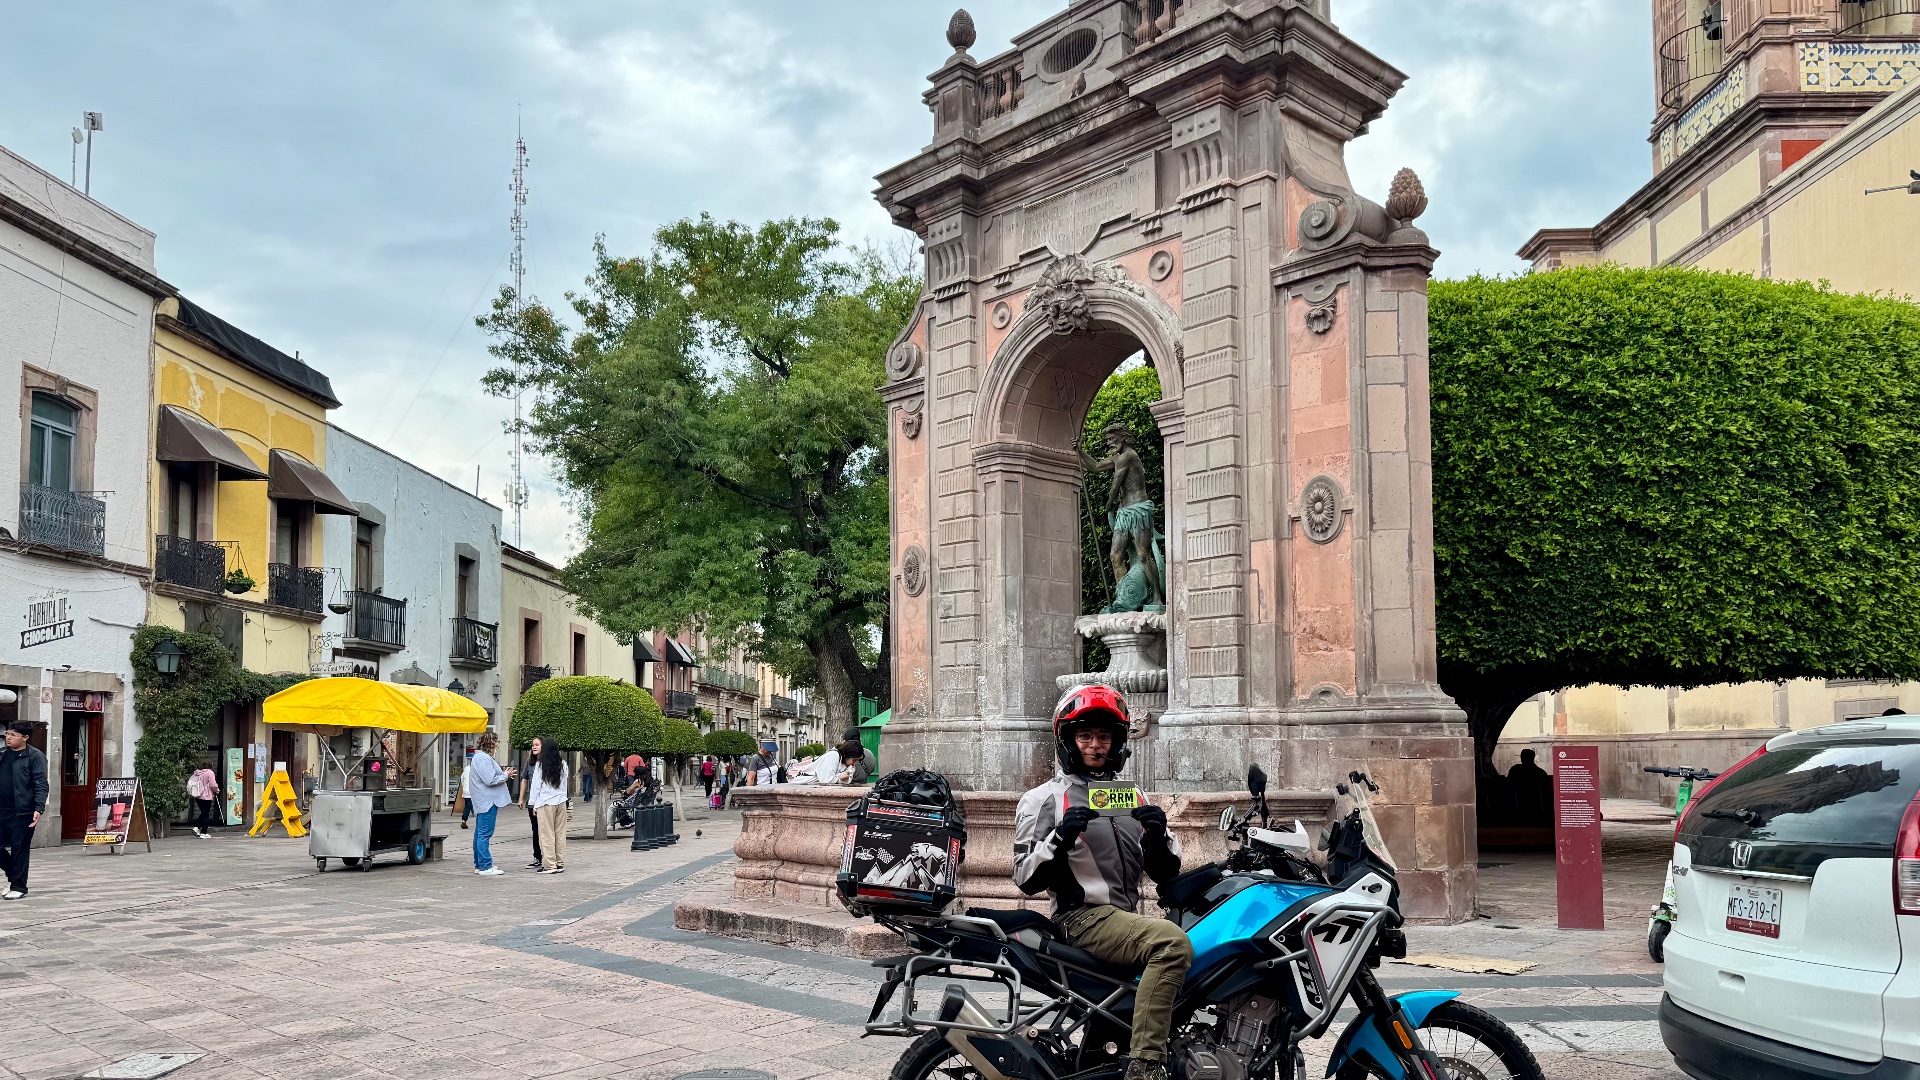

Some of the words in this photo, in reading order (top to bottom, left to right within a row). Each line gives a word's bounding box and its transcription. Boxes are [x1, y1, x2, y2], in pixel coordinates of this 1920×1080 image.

[59, 597, 67, 621] DE
[23, 622, 71, 647] CHOCOLATE
[1110, 793, 1133, 803] RRM
[879, 806, 934, 817] DISCOVERY
[1727, 896, 1777, 923] MFS-219-C
